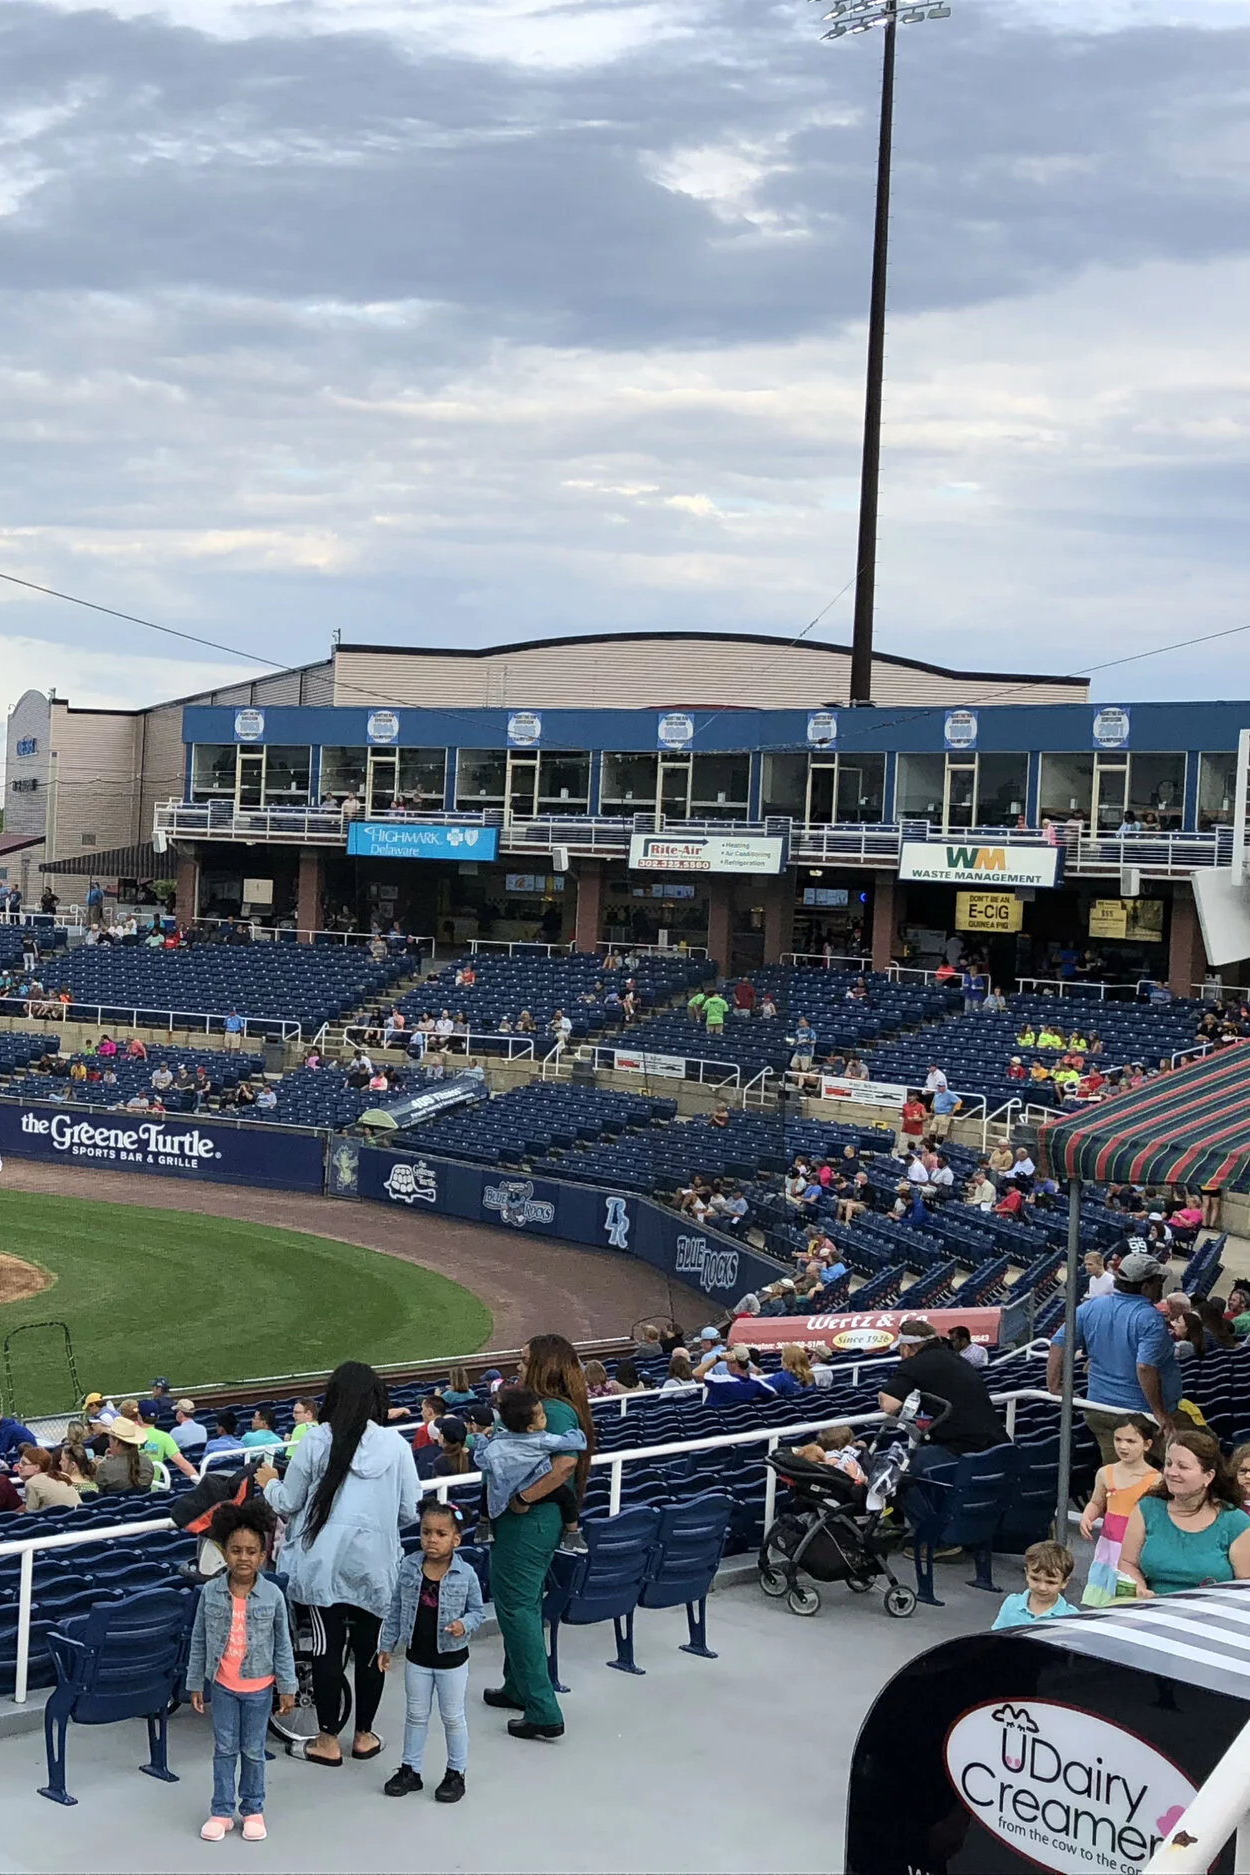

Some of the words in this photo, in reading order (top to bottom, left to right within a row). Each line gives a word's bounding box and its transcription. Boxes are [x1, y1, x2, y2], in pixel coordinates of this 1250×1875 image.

[365, 827, 440, 845] HIGHMARK
[370, 844, 420, 856] Delaware
[651, 844, 702, 855] Rite-Air
[726, 842, 750, 850] Heating
[724, 859, 766, 867] Refrigeration
[946, 847, 1006, 871] WM
[912, 870, 951, 879] WASTE
[955, 872, 1042, 883] MANAGEMENT
[968, 903, 1009, 920] E-CIG
[996, 921, 1009, 930] PIG
[21, 1113, 49, 1134] the
[50, 1115, 138, 1150] Greene
[139, 1123, 214, 1158] Turtle
[72, 1146, 116, 1159] SPORTS
[120, 1152, 143, 1162] BAR
[147, 1154, 154, 1163] &
[158, 1156, 199, 1169] GRILLE
[1129, 1241, 1148, 1253] 99
[676, 1235, 706, 1271] BLUE
[700, 1249, 739, 1293] ROCKS
[807, 1314, 874, 1331] Wertz
[876, 1313, 895, 1327] &
[838, 1334, 864, 1344] Since
[866, 1334, 890, 1343] 1926
[1002, 1727, 1148, 1822] UDairy
[961, 1762, 1165, 1862] Creamer
[998, 1816, 1026, 1837] from
[1029, 1829, 1050, 1845] the
[1052, 1839, 1077, 1855] cow
[1080, 1847, 1093, 1861] to
[1096, 1852, 1117, 1870] the
